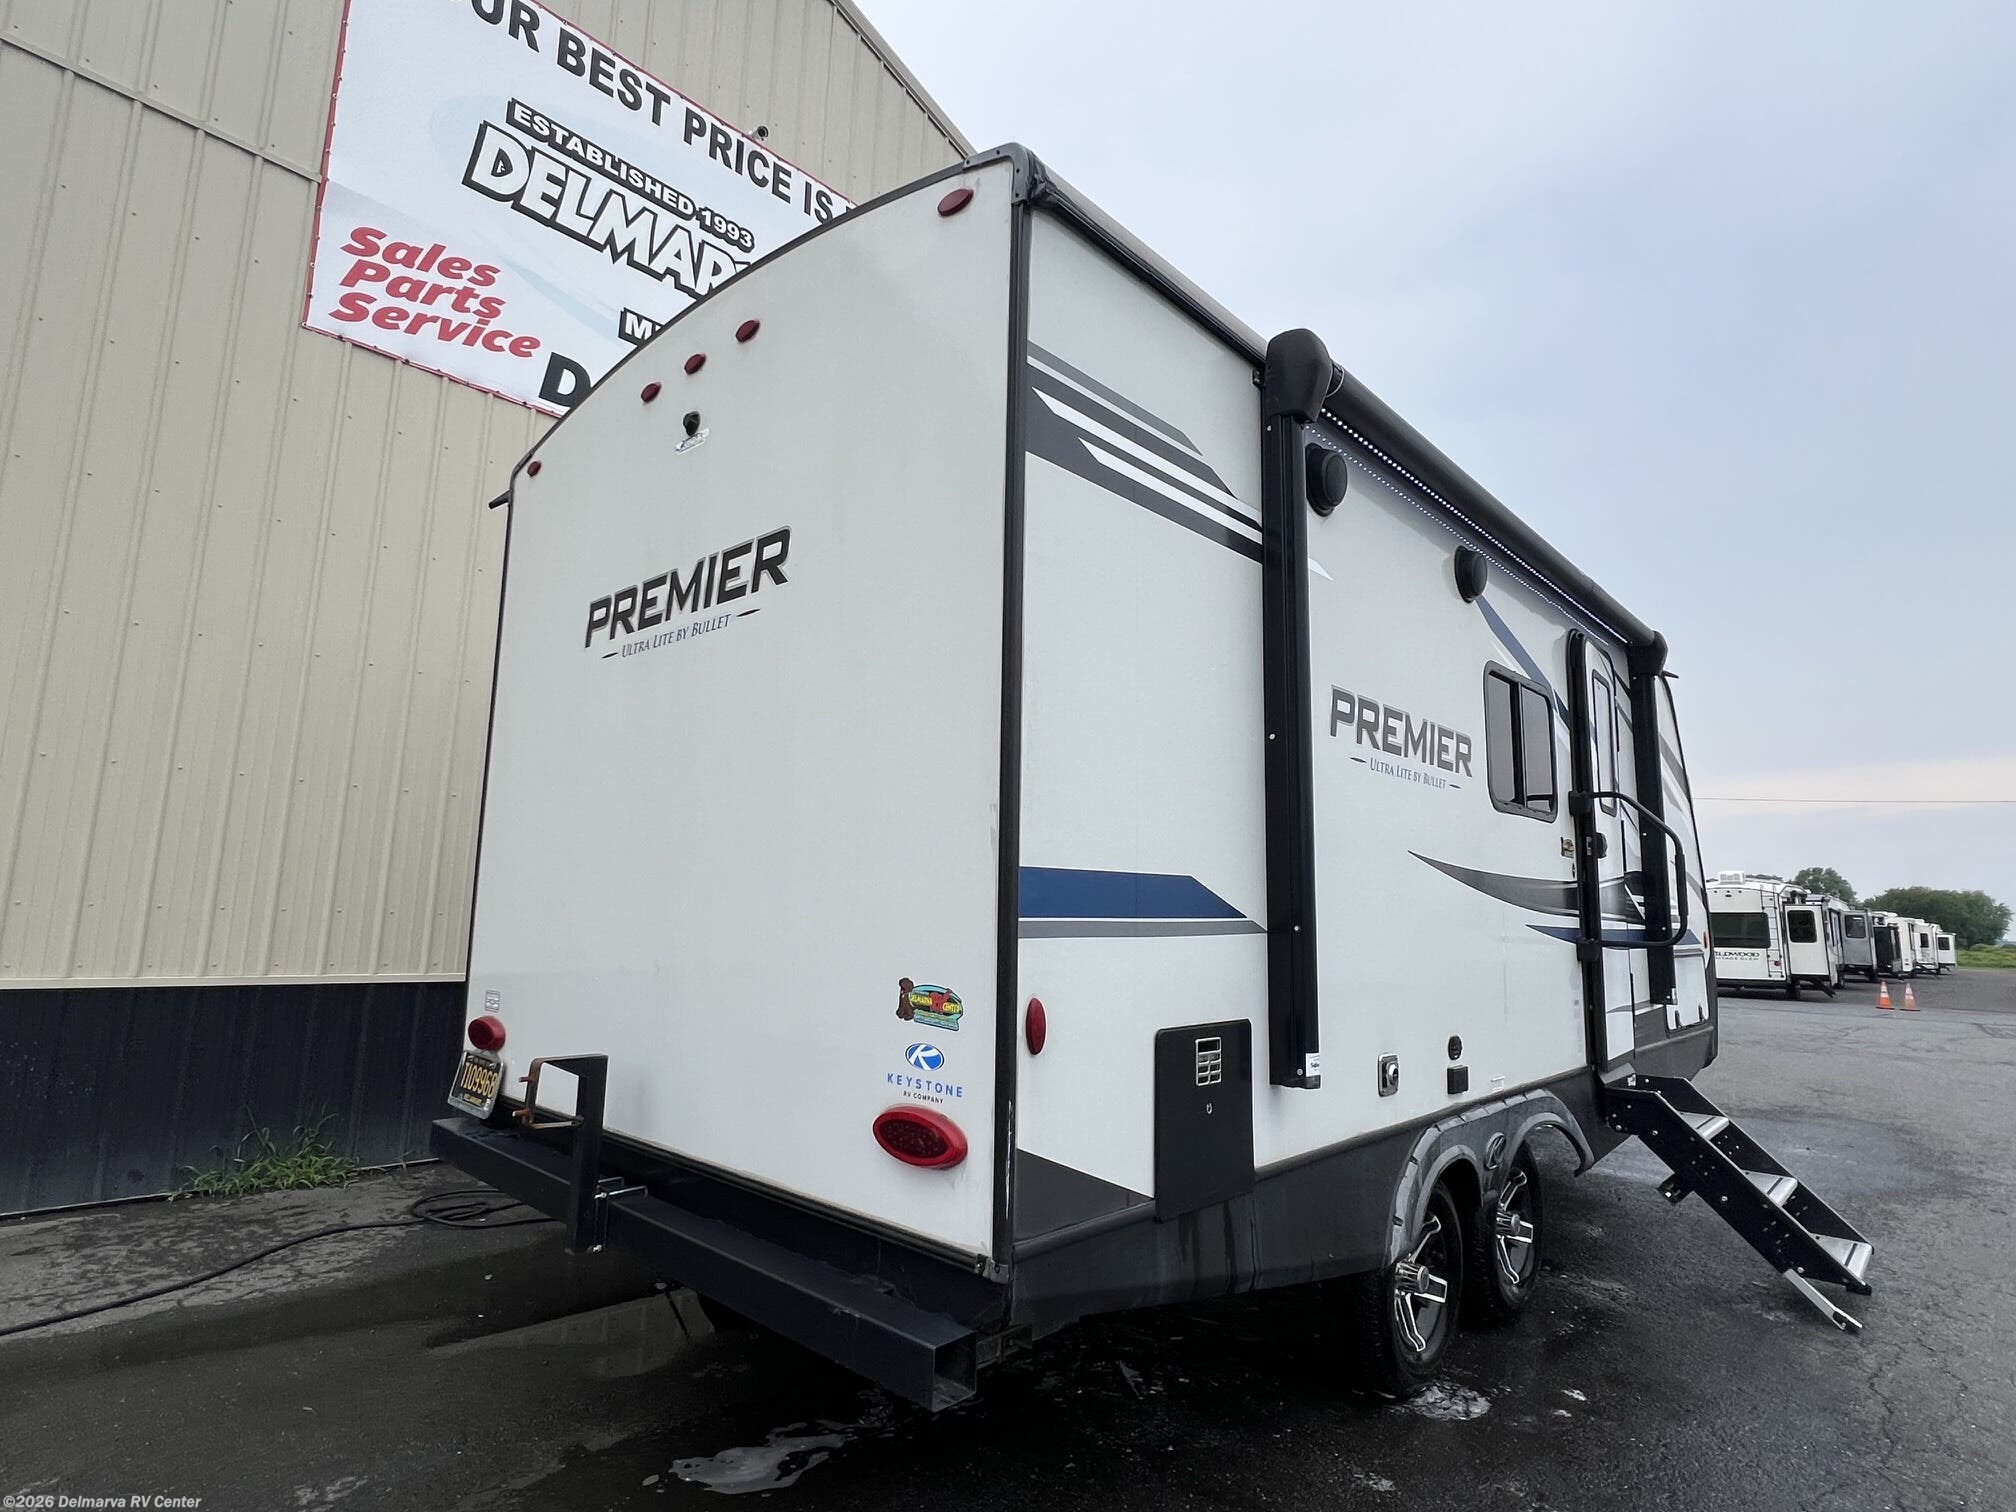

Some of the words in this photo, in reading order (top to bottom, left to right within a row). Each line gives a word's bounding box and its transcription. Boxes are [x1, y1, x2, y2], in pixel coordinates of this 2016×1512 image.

[556, 27, 671, 126] BEST
[684, 106, 792, 204] PRICE
[804, 180, 833, 224] IS
[505, 97, 698, 221] ESTABLISHED
[697, 206, 755, 253] 1993
[461, 120, 751, 298] DELMAR
[339, 258, 507, 319] Parts
[340, 227, 501, 287] Sales
[328, 292, 541, 358] Service
[584, 525, 791, 649] PREMIER
[653, 632, 675, 649] LITE
[676, 626, 690, 642] BY
[691, 613, 732, 636] BULLET
[1330, 684, 1473, 777] PREMIER
[887, 1073, 963, 1098] KEYSTONE
[903, 1090, 912, 1098] RV
[913, 1093, 944, 1104] COMPANY
